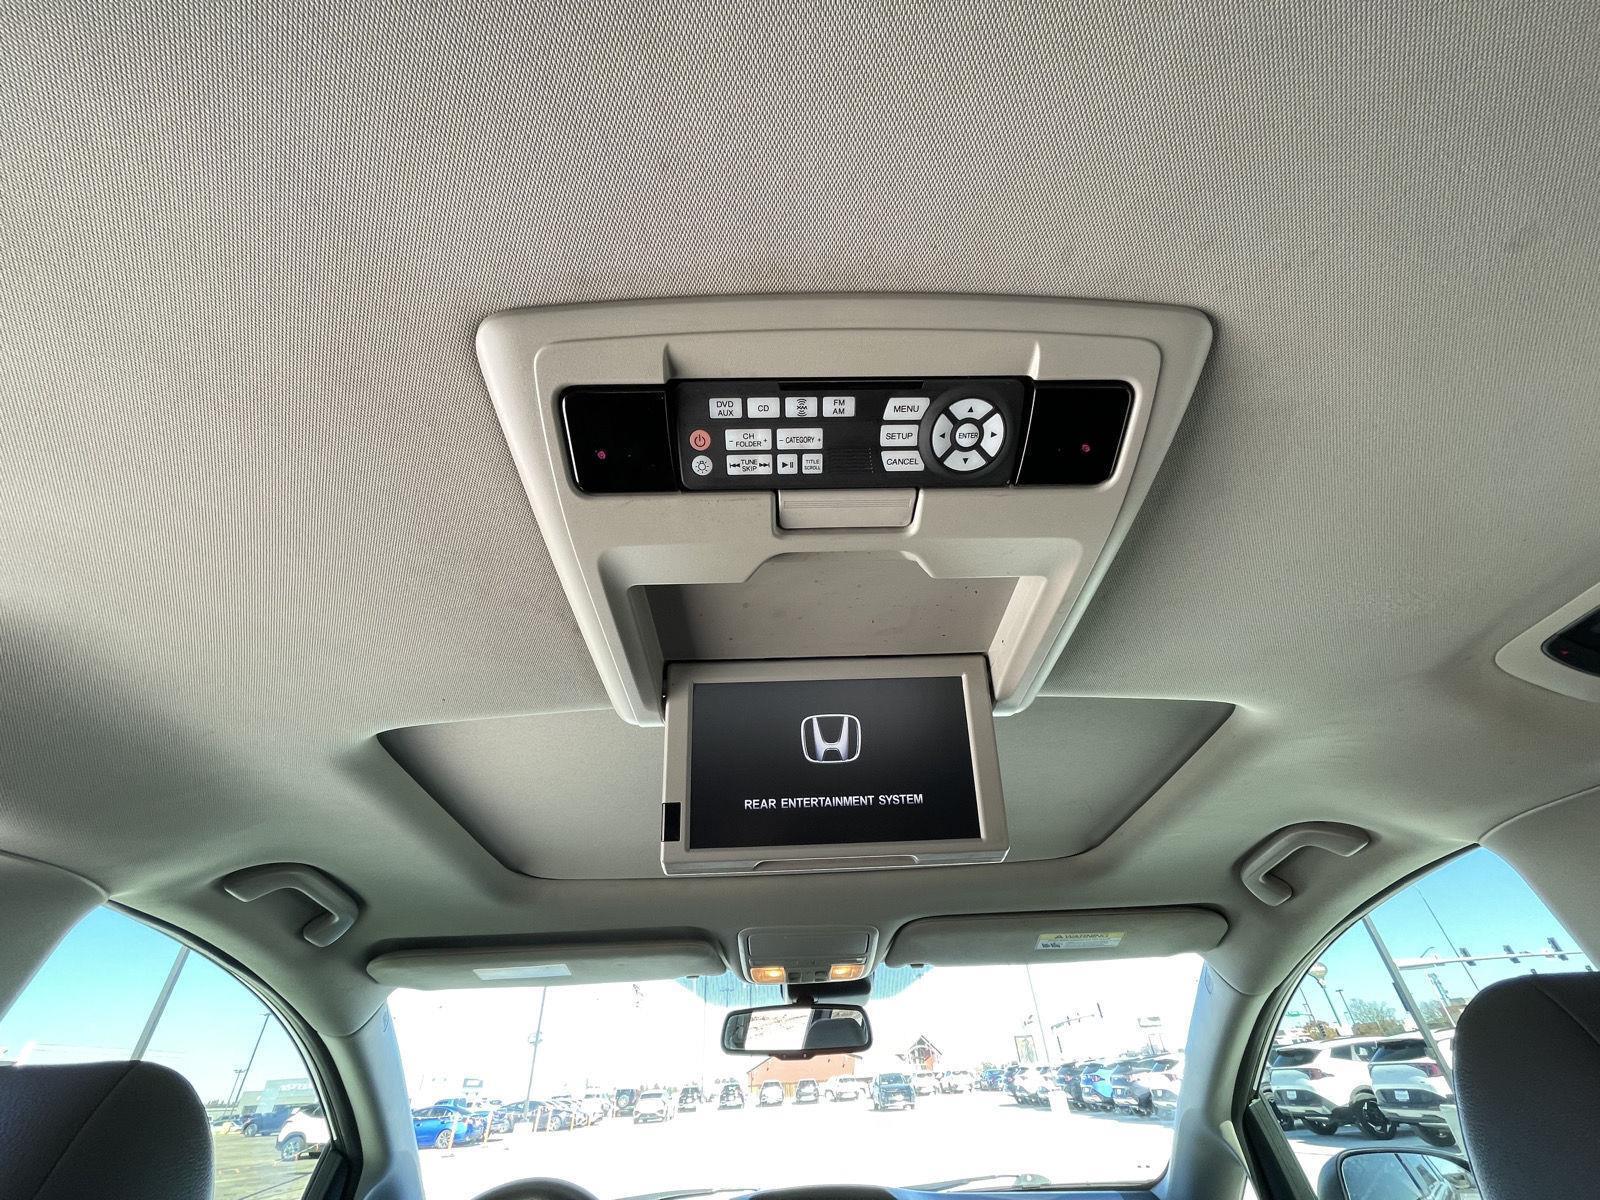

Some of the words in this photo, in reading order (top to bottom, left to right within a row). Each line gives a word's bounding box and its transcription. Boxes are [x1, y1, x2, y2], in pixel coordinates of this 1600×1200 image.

[833, 399, 846, 407] FM
[717, 409, 734, 417] AUX
[893, 405, 920, 413] MENU
[785, 436, 815, 444] CATEGORY
[885, 432, 914, 440] SETUP
[886, 458, 919, 466] CANCEL
[744, 798, 777, 810] REAR
[780, 795, 875, 809] ENTERTAINMENT
[878, 793, 924, 805] SYSTEM
